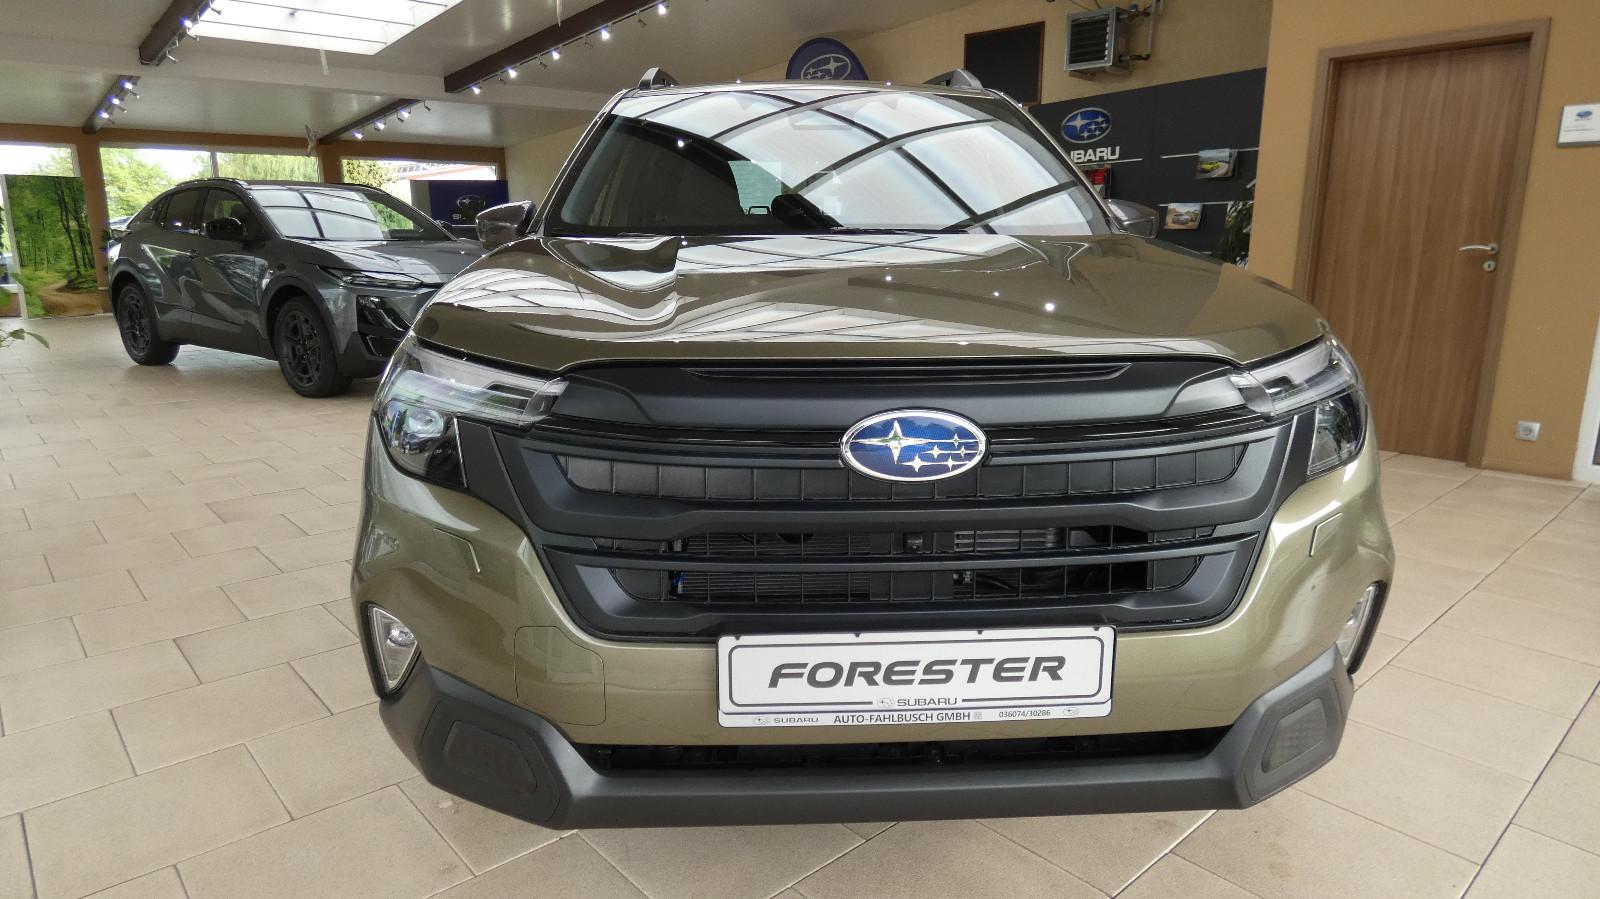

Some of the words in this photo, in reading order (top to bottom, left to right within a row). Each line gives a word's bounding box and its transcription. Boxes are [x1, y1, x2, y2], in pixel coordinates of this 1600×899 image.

[1071, 146, 1120, 163] BARU
[768, 655, 1066, 688] FORESTER
[897, 698, 957, 707] SUBARU
[834, 713, 933, 724] AUTO-FAHLBUSCH
[937, 712, 971, 721] GMBH
